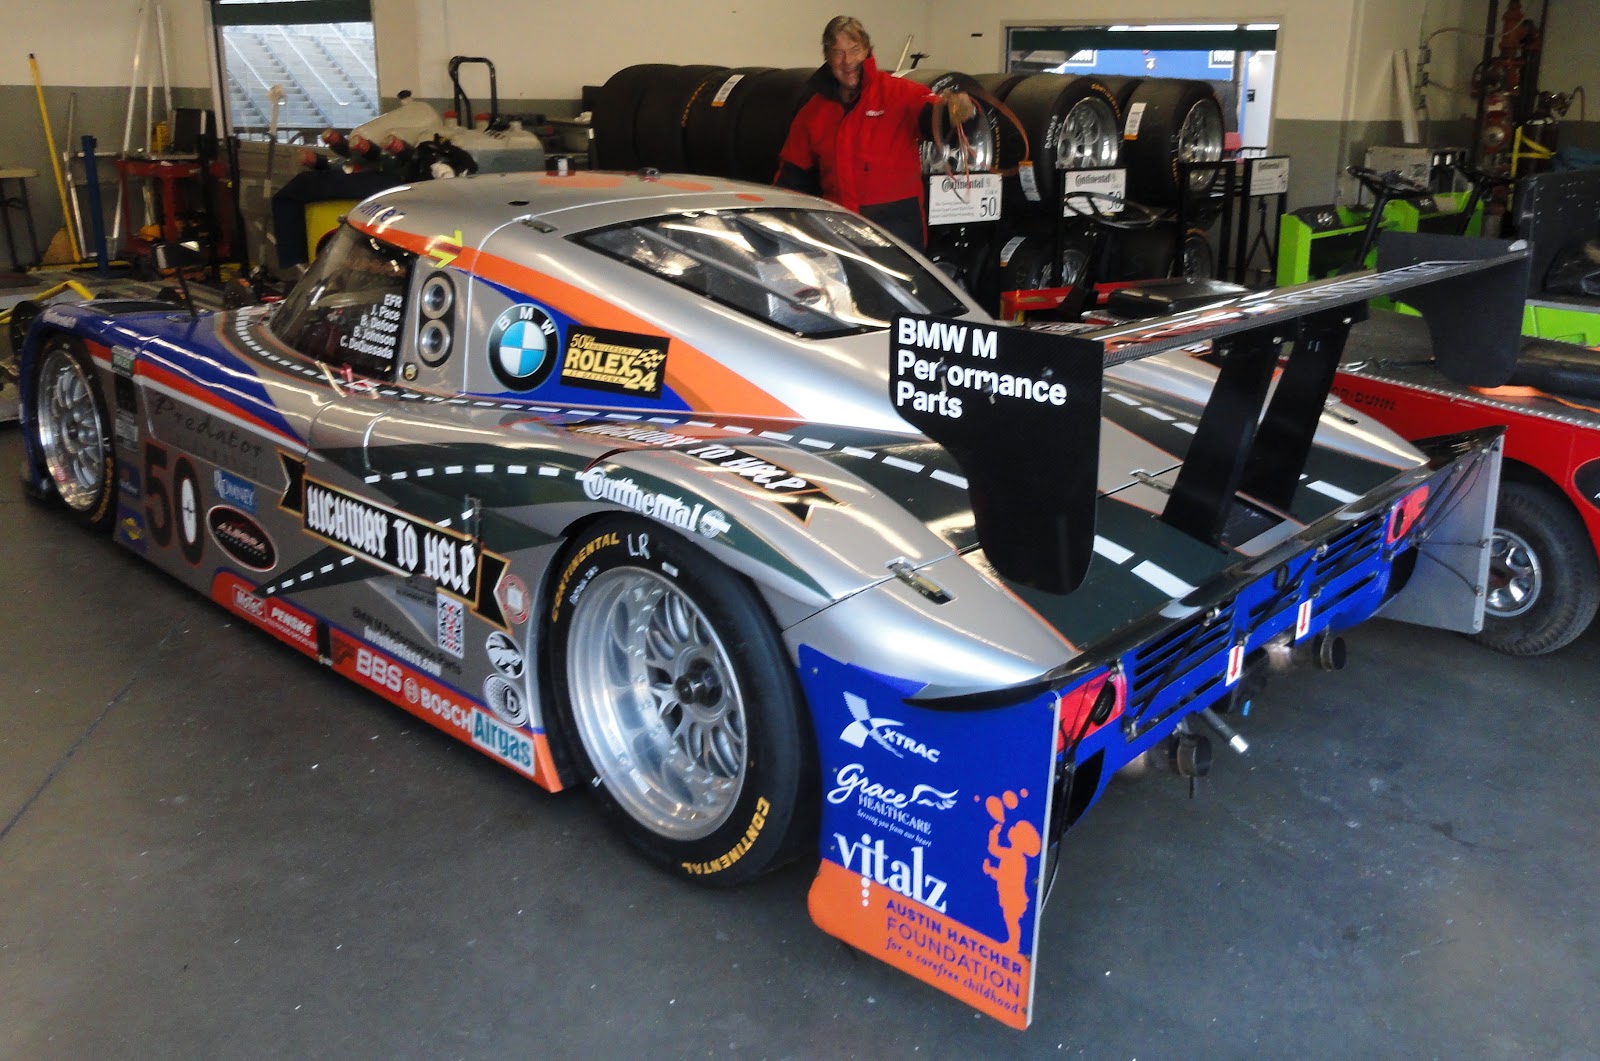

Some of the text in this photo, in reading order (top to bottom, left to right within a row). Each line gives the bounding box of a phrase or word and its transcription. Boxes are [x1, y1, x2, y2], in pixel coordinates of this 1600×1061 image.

[980, 196, 997, 217] 50
[379, 305, 401, 321] Pace
[384, 293, 403, 308] EFR
[497, 306, 557, 336] BMW
[362, 328, 397, 346] Johnson
[898, 317, 998, 360] BMW M
[563, 347, 657, 392] ROLEX 24
[897, 349, 1067, 407] Perormance
[896, 380, 963, 419] Parts
[145, 438, 206, 568] 50
[582, 466, 704, 532] Continental
[307, 484, 389, 559] HIGHWAY
[392, 518, 419, 572] TO
[423, 531, 477, 595] HELP
[627, 533, 651, 560] LR
[356, 648, 403, 693] BBS
[420, 687, 473, 734] BOSCH
[473, 709, 532, 768] Airgas
[882, 727, 941, 763] XTRAC
[826, 762, 909, 808] Grace
[681, 796, 771, 875] CONTINENTAL
[858, 793, 932, 835] HEALTHCARE
[834, 832, 948, 914] vitalz
[886, 899, 1022, 977] AUSTIN HATCHER
[886, 916, 1021, 998] FOUNDATION
[885, 937, 1020, 1015] for a carefree childhood
